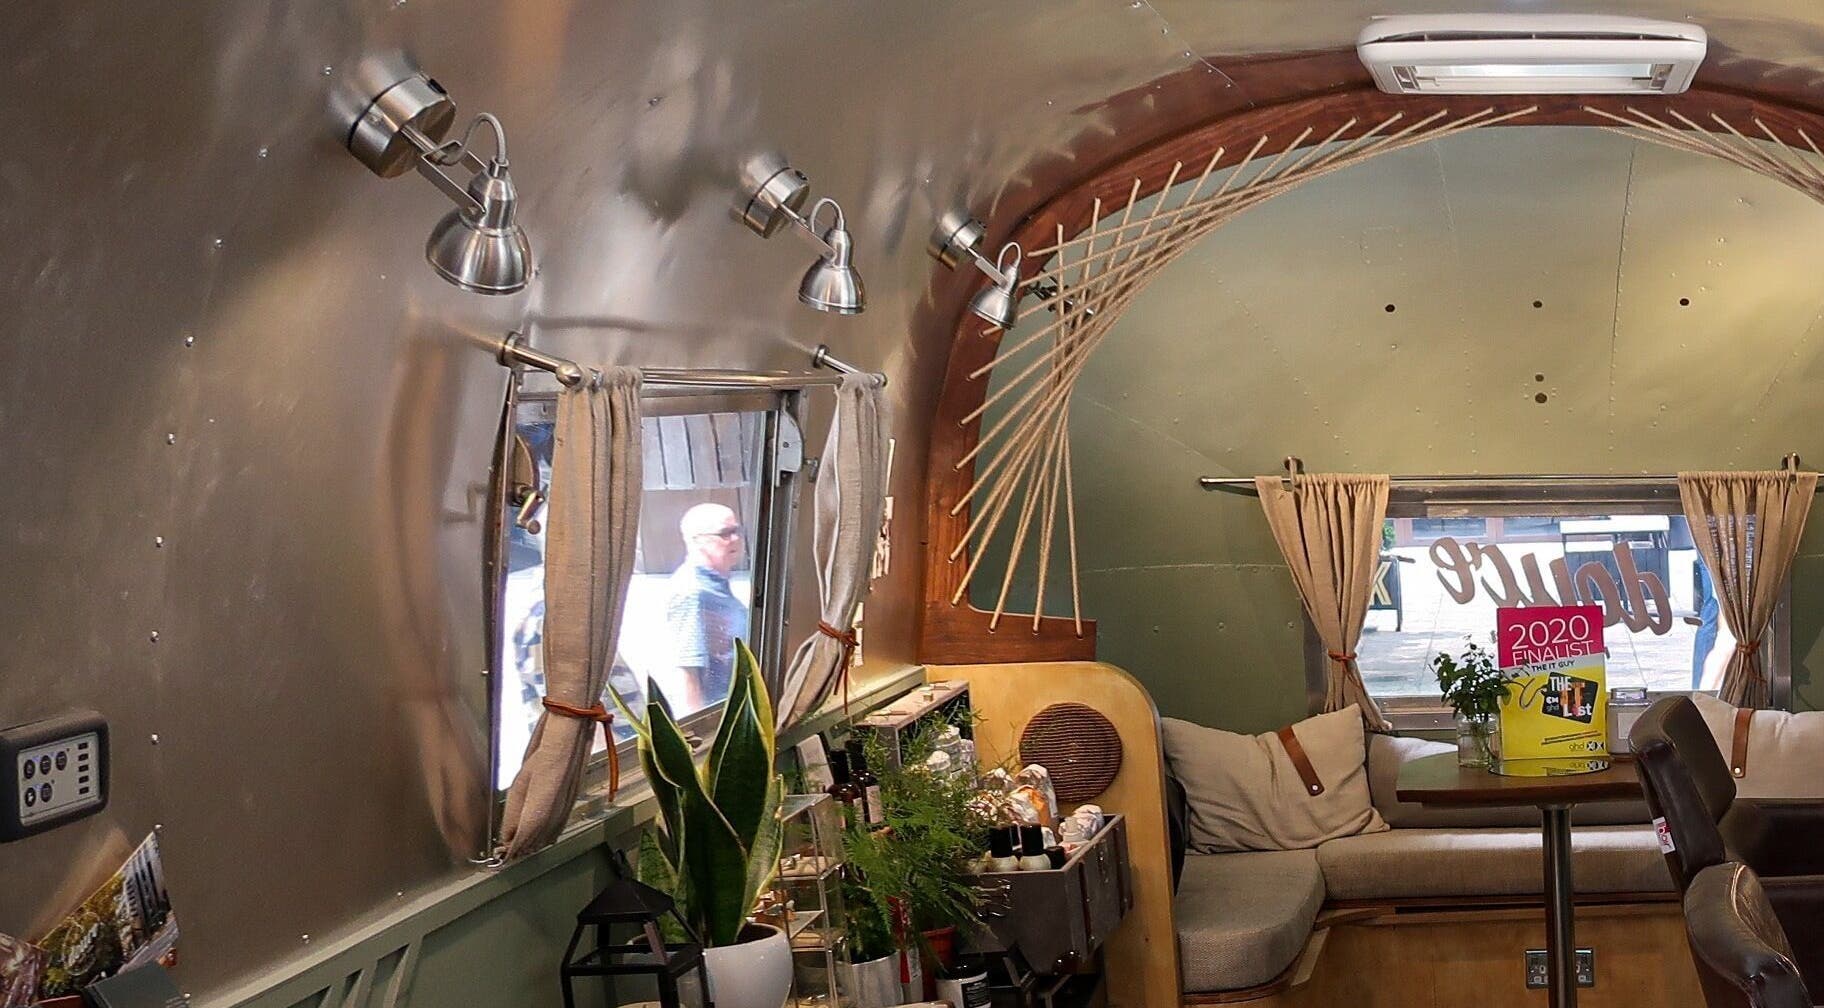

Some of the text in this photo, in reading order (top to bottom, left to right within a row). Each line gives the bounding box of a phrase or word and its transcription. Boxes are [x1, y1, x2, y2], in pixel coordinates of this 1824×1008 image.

[1508, 615, 1590, 650] 2020
[1512, 640, 1594, 667] FINALIST
[1531, 664, 1547, 672] THE
[1558, 660, 1575, 668] GUY
[1550, 676, 1572, 691] THE
